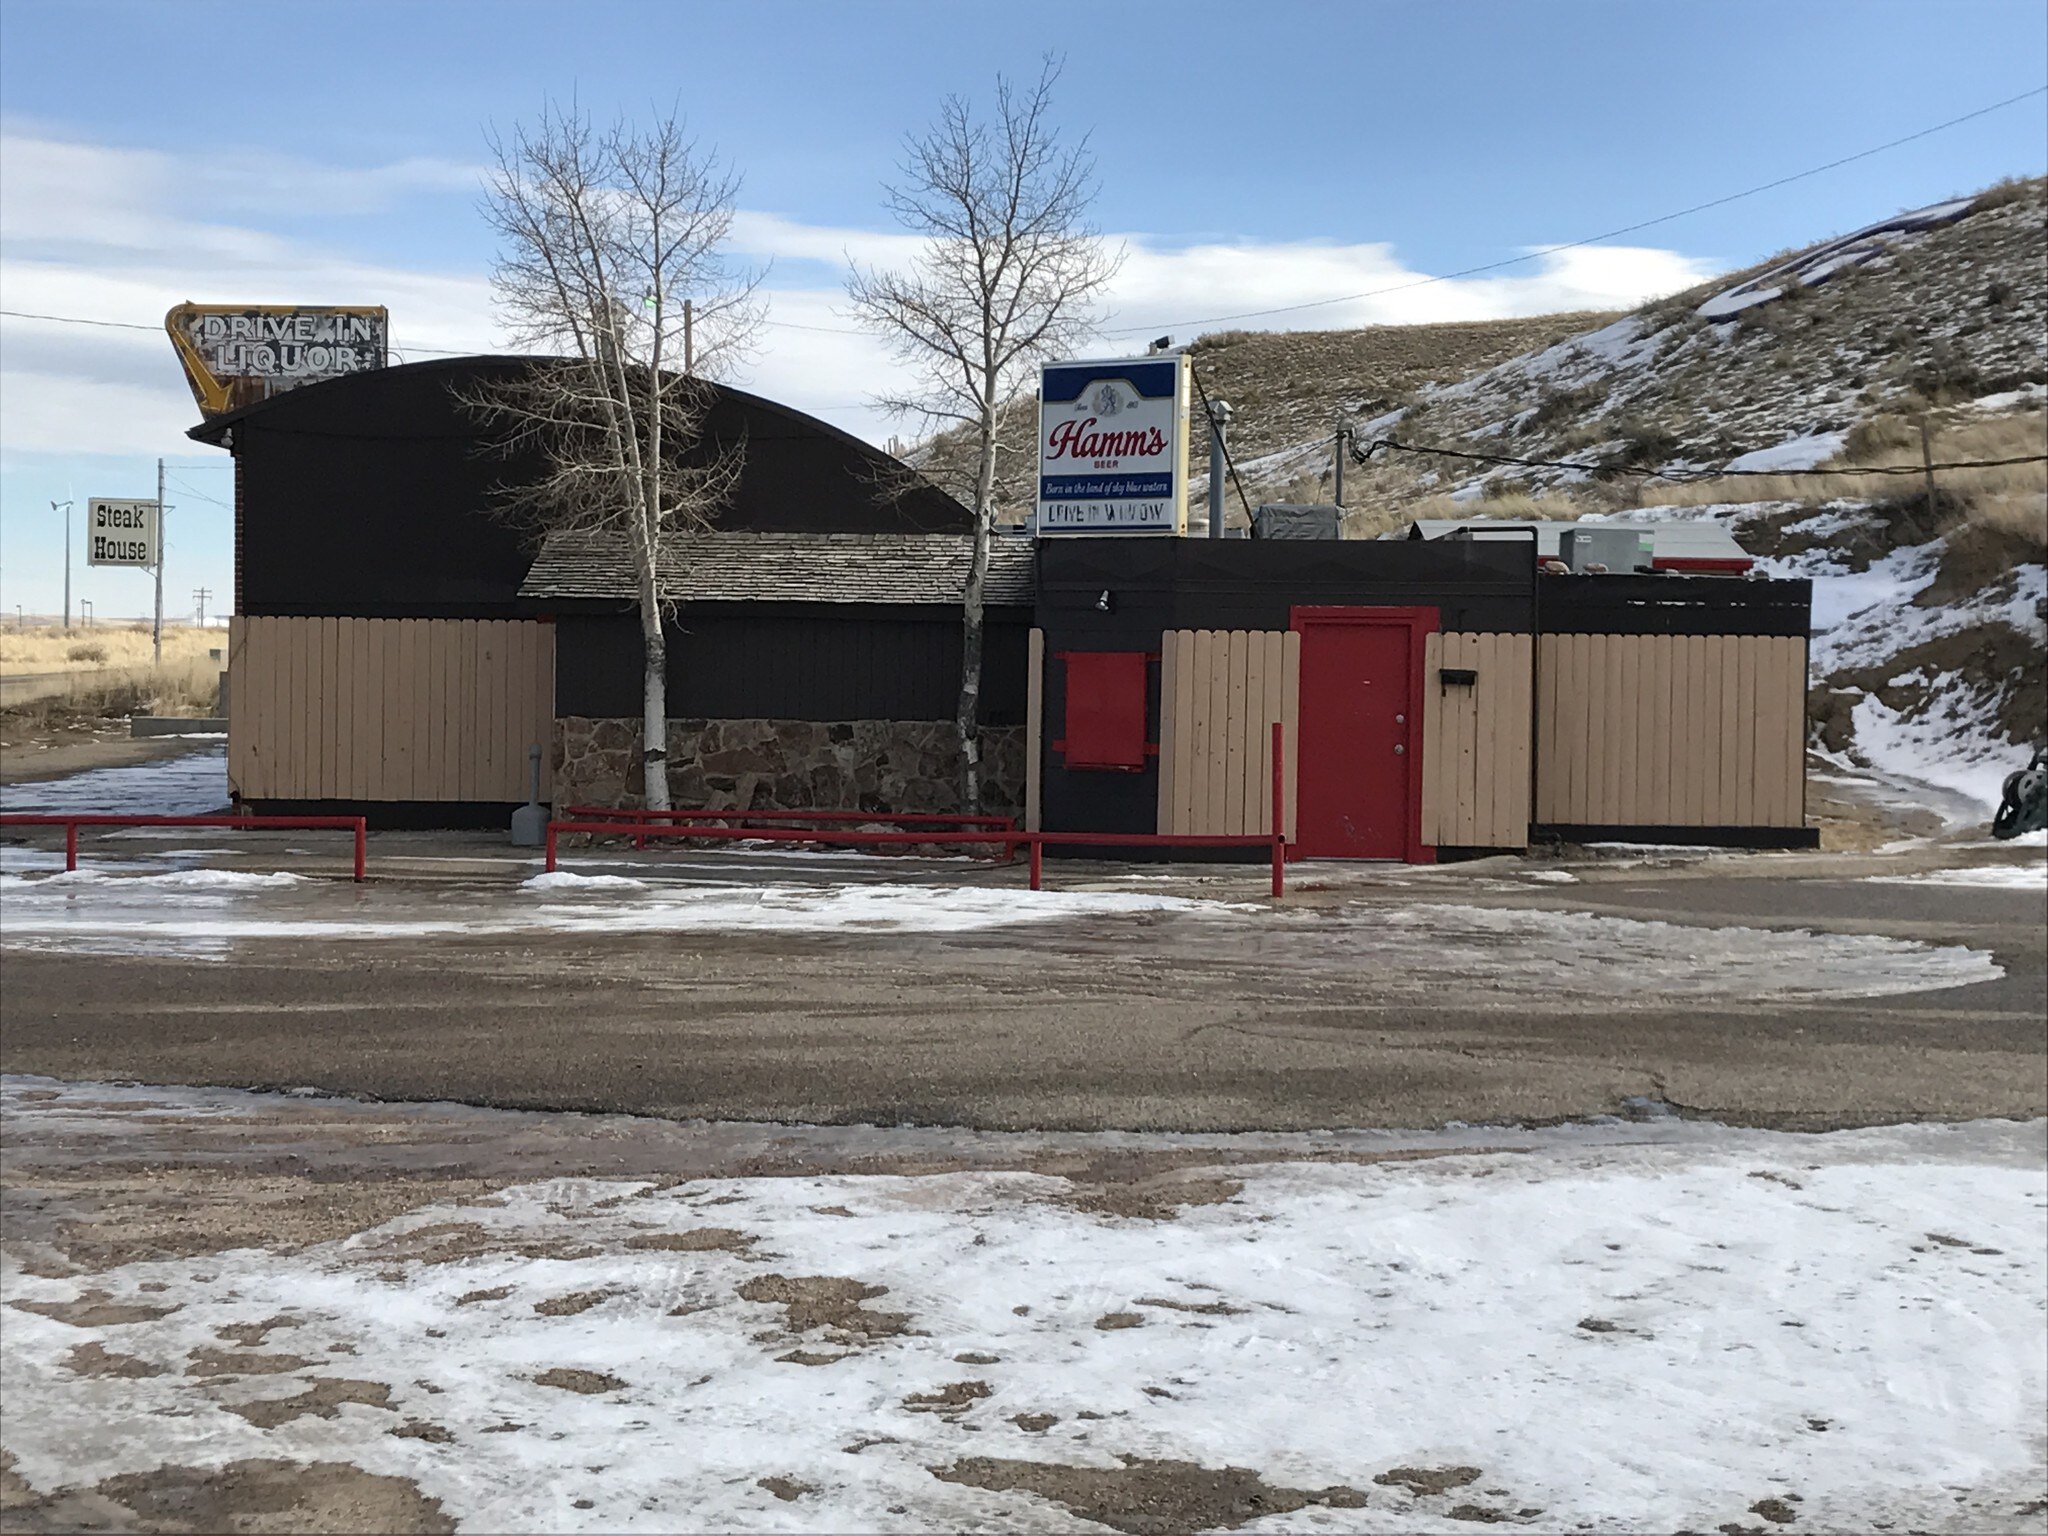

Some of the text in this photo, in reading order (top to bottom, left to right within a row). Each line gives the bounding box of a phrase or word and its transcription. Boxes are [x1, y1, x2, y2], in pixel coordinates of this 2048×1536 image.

[203, 315, 371, 341] DRIVE IN
[216, 346, 359, 373] LIQUOR
[1045, 417, 1168, 460] Hamm's
[1093, 460, 1119, 469] BEER
[1045, 481, 1168, 496] Born in the land of sky blue waters
[96, 504, 144, 528] Steak
[94, 536, 146, 560] House
